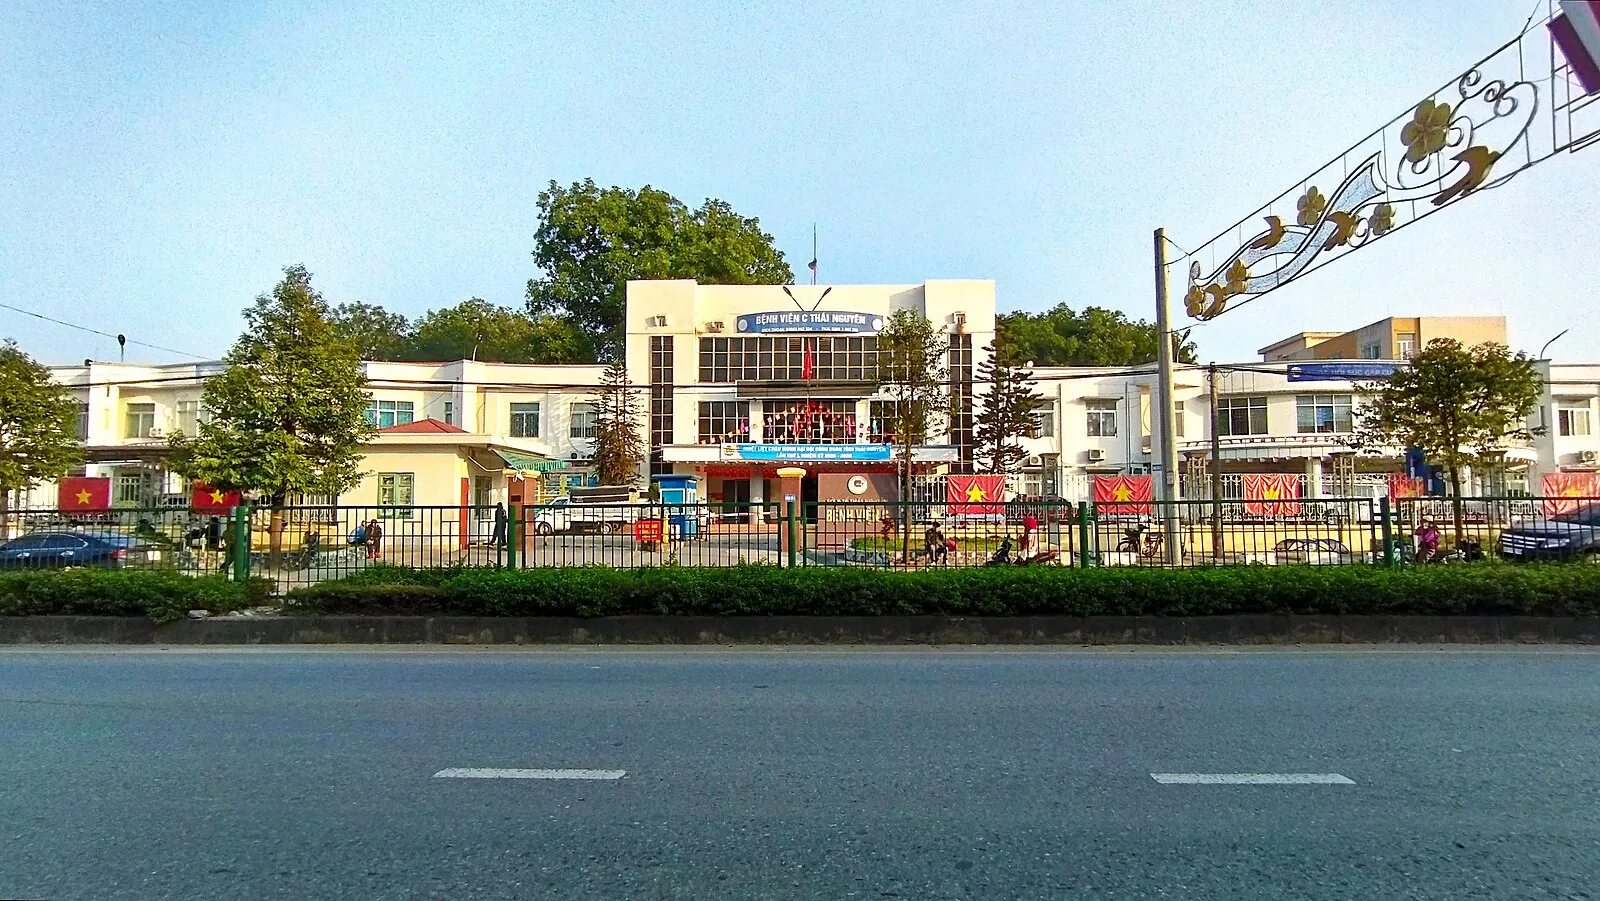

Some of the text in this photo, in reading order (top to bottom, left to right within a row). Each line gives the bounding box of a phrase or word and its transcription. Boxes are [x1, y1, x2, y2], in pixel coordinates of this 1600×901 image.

[756, 313, 866, 325] BỆNH VIỆN C THÁI NGUYÊN
[826, 505, 854, 523] BỆNH
[855, 506, 880, 525] VIỆN
